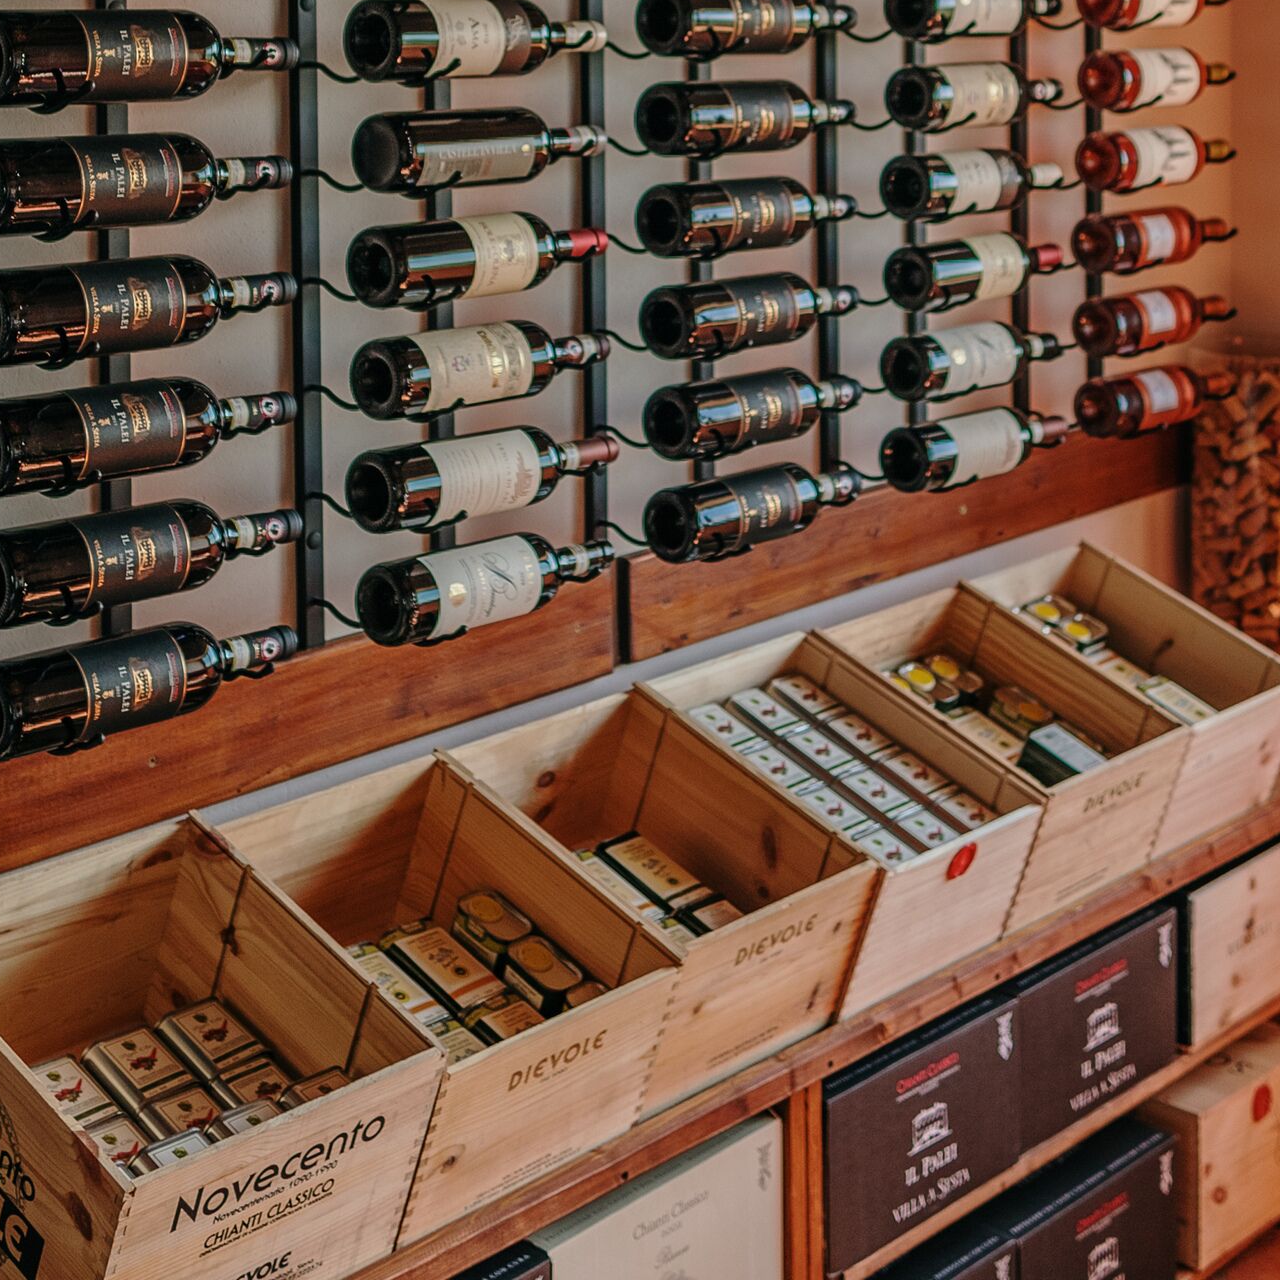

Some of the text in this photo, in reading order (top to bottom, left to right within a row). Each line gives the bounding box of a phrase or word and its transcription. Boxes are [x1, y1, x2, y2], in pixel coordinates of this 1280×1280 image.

[735, 913, 818, 967] DIEVOLE
[508, 1029, 609, 1092] DIEVOLE
[169, 1115, 385, 1234] Novecento
[203, 1212, 263, 1249] CHIANTI
[267, 1179, 335, 1219] CLASSICO
